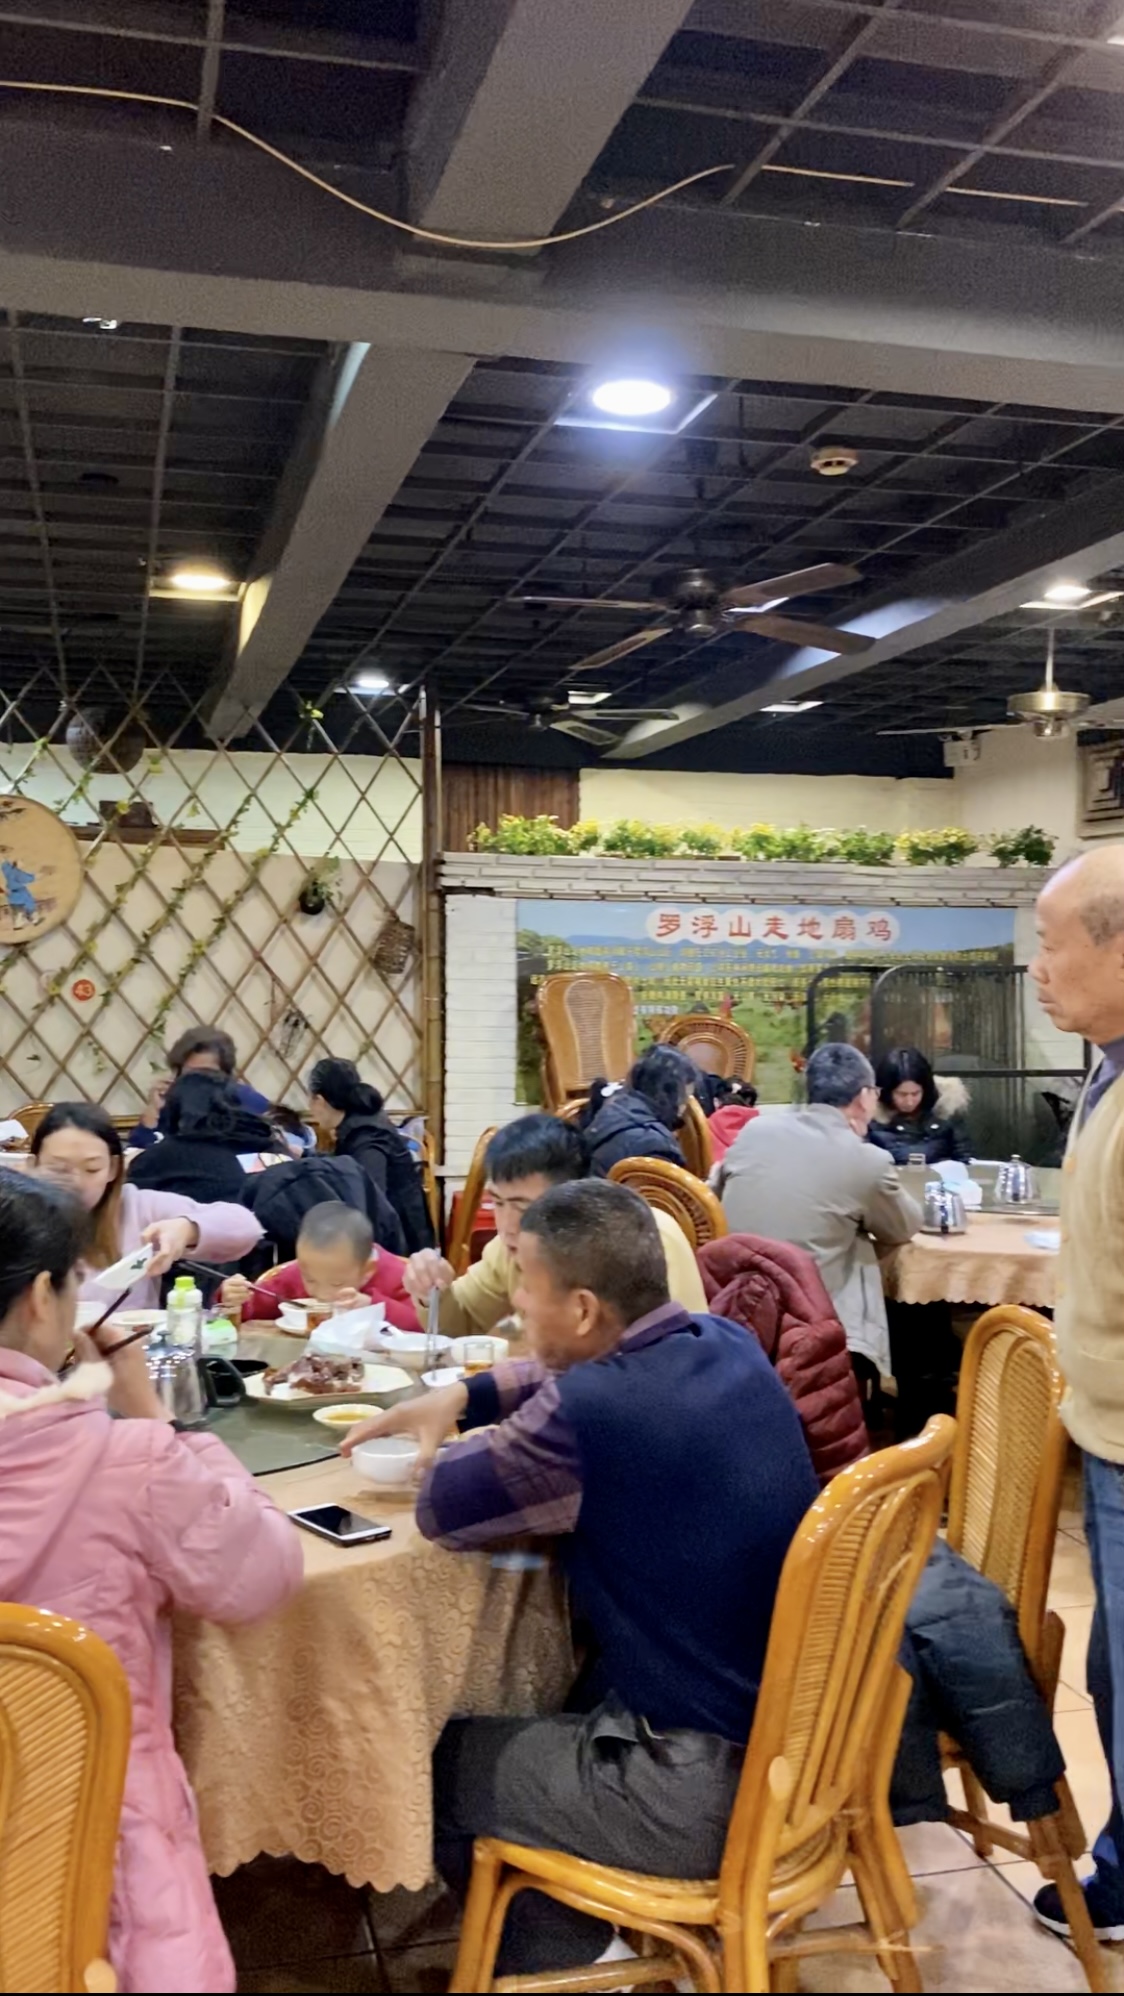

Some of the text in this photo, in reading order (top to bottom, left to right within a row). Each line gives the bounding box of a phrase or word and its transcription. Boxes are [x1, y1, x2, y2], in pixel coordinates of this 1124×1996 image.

[655, 913, 892, 941] 罗浮山走地扇鸡
